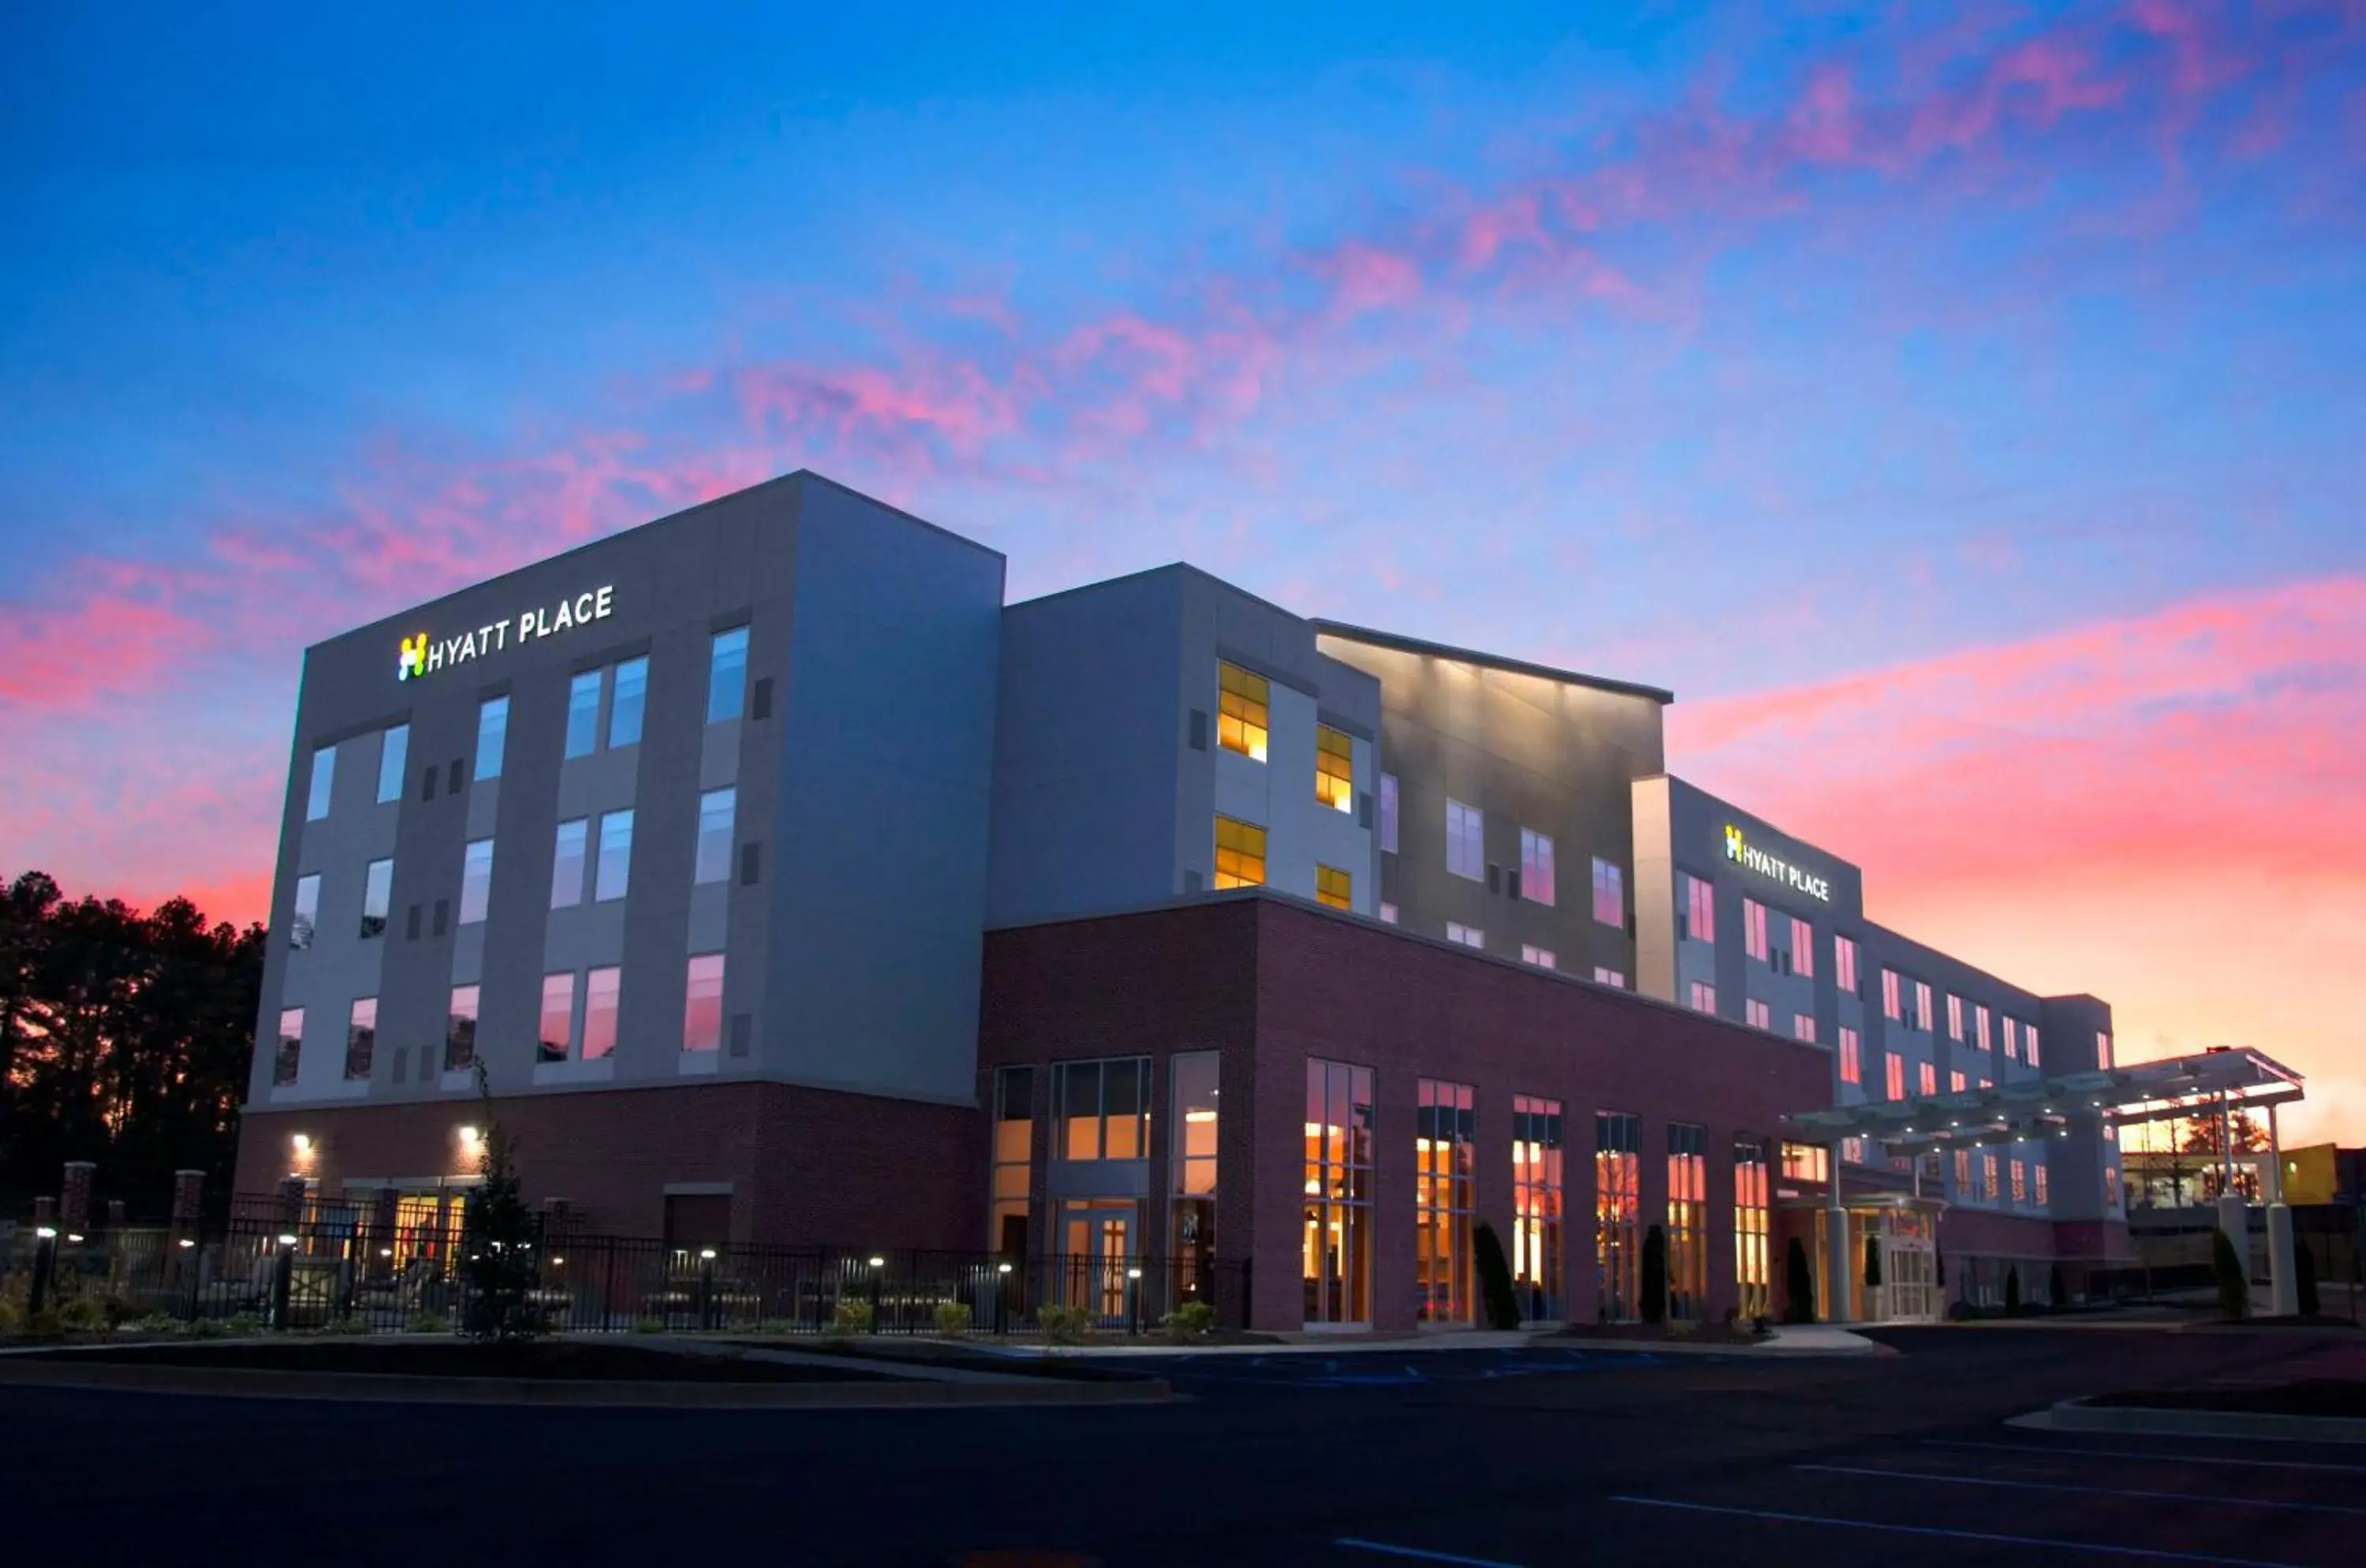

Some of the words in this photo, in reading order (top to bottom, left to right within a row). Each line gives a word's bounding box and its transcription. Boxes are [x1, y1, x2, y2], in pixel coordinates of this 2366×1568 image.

[427, 620, 510, 673] HYATT
[519, 584, 614, 644] PLACE
[1743, 845, 1786, 883] HYATT
[1788, 865, 1830, 902] PLACE
